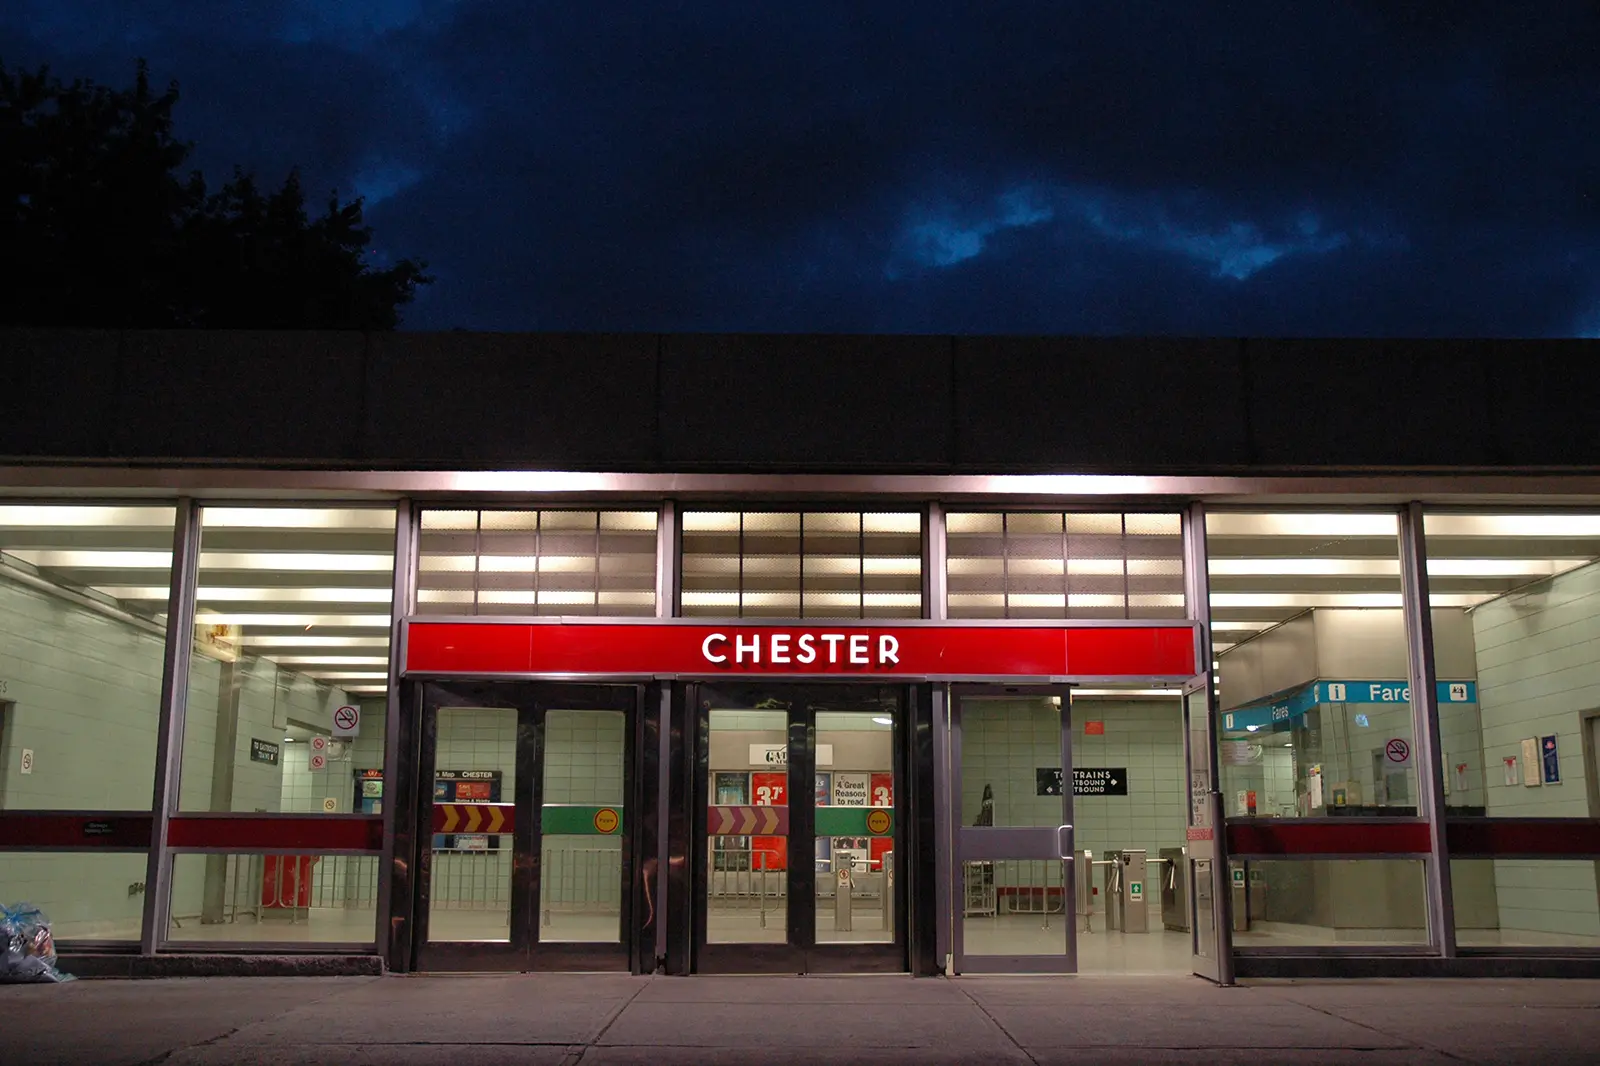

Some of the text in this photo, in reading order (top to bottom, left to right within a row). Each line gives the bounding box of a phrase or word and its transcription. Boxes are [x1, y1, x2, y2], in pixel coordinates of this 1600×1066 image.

[701, 633, 900, 664] CHESTER
[1369, 684, 1411, 702] Fare
[1271, 705, 1289, 721] Fares
[765, 750, 788, 763] GAT
[1073, 771, 1111, 779] TRAINS
[836, 781, 865, 789] 4 Great
[835, 790, 867, 798] Reasons
